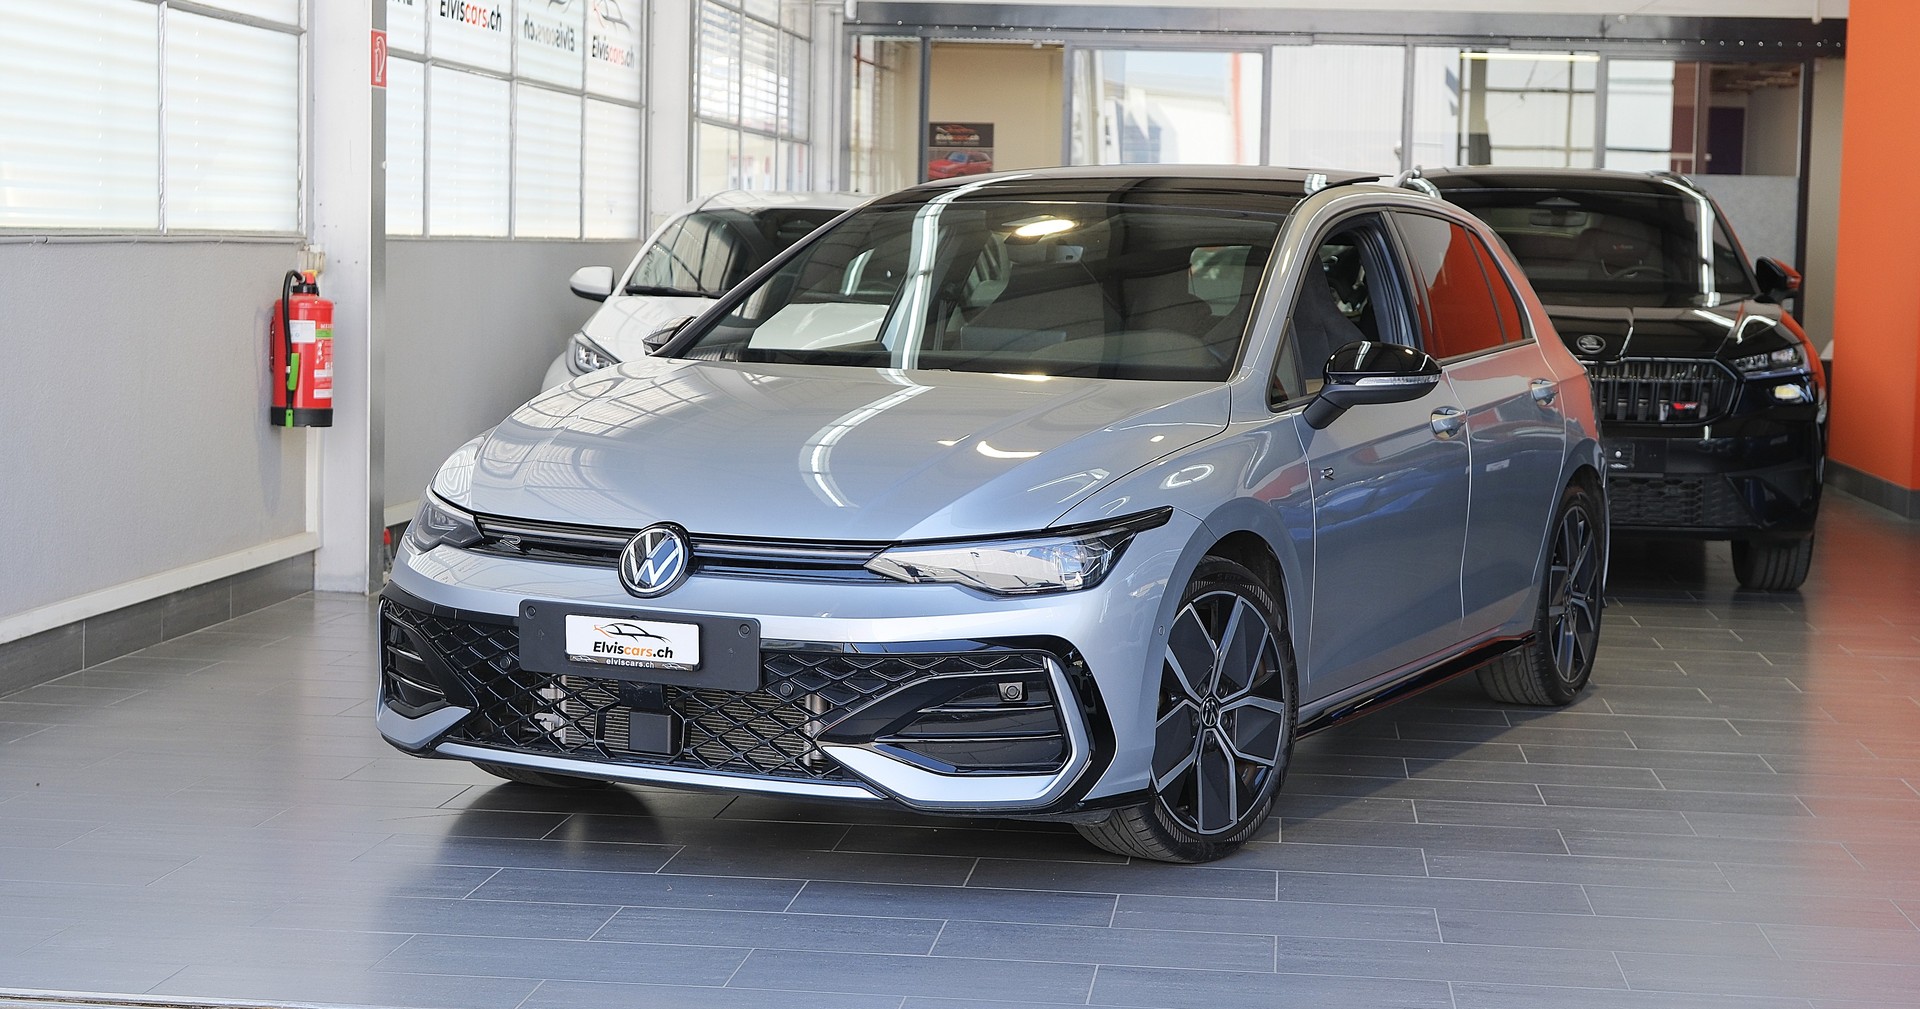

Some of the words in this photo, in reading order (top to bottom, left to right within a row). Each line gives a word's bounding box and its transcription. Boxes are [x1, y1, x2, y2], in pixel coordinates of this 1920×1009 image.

[440, 0, 502, 32] Elviscars.ch
[593, 641, 674, 659] Elviscars.ch
[606, 657, 655, 669] elviscars.ch
